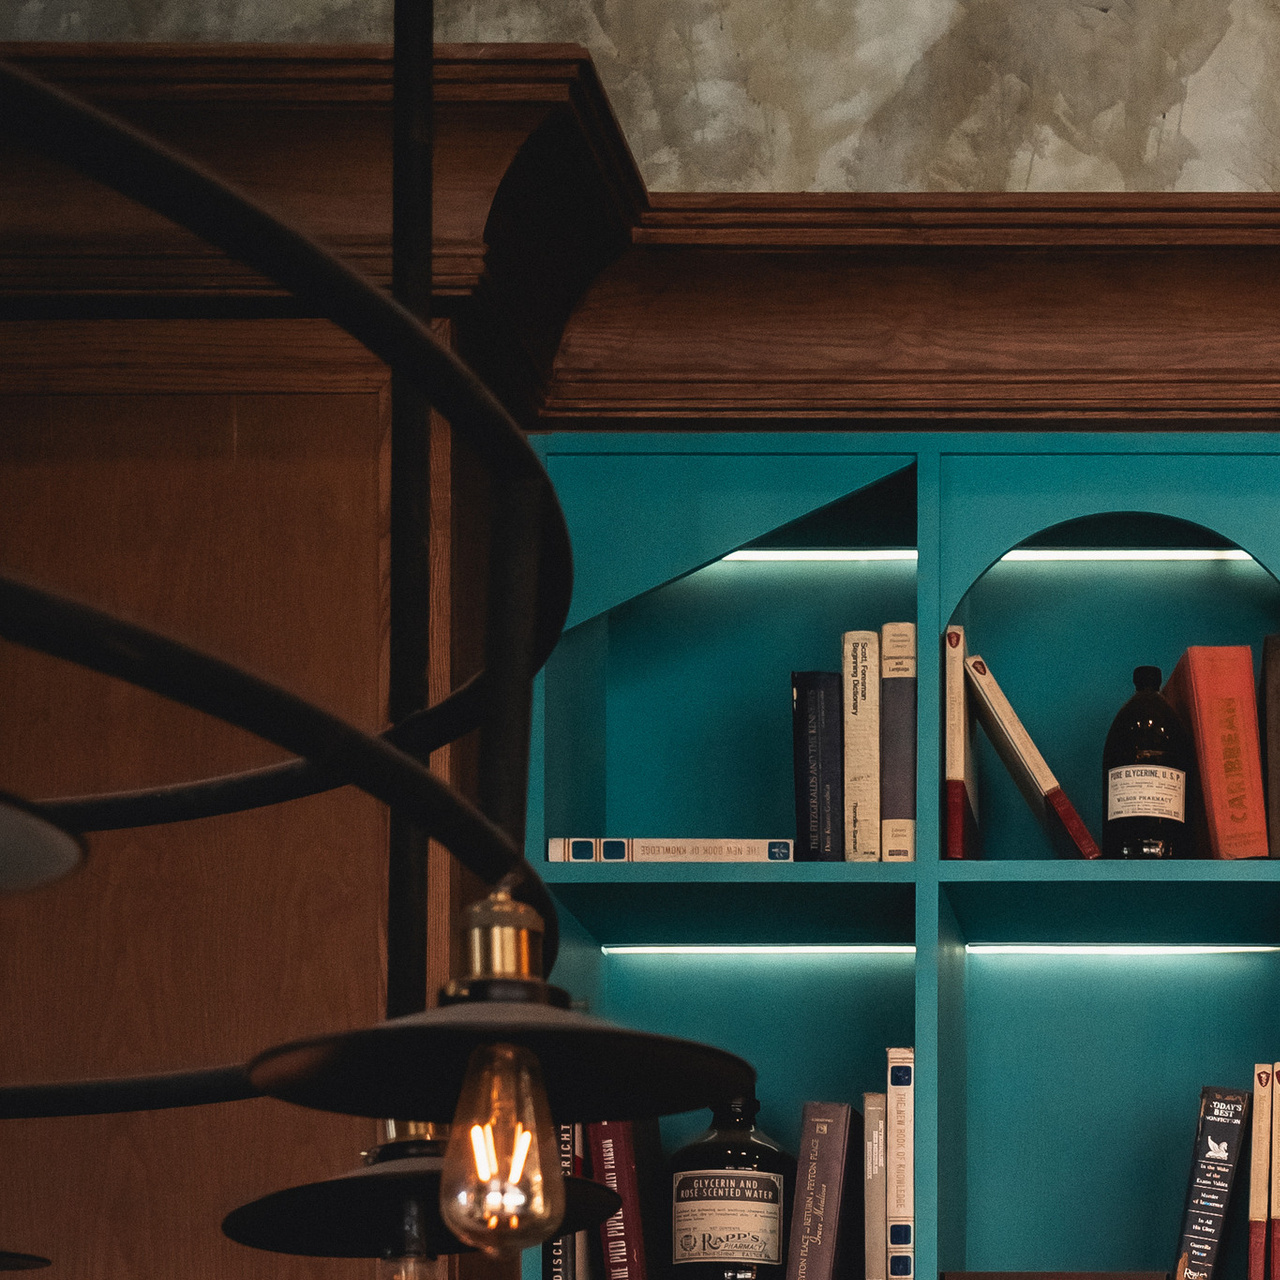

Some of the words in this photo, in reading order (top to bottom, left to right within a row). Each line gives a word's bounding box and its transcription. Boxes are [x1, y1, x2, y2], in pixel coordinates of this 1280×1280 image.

[851, 679, 860, 716] Dictionary
[1221, 697, 1248, 824] CARIBBEAN
[1139, 796, 1173, 804] PHARMACY
[641, 845, 687, 855] KNOWLEDGE
[703, 845, 723, 855] BOOK
[726, 845, 743, 855] NEW
[896, 1092, 906, 1107] THE
[1213, 1108, 1235, 1118] BEST
[896, 1129, 906, 1149] BOOK
[601, 1139, 615, 1169] PEARSON
[809, 1139, 820, 1161] PLACE
[896, 1152, 906, 1161] OF
[693, 1179, 736, 1188] GLYCERIN
[740, 1180, 758, 1189] AND
[807, 1162, 818, 1190] PEYTON
[680, 1188, 741, 1199] ROSE-SCENTED
[745, 1189, 773, 1200] WATER
[896, 1164, 906, 1208] KNOWLEDGE
[803, 1196, 814, 1226] RETURN
[702, 1232, 760, 1251] RAPP'S
[810, 1223, 824, 1245] Grace
[608, 1240, 627, 1263] PIED
[723, 1242, 763, 1250] PHARMACY
[799, 1235, 811, 1257] PLACE
